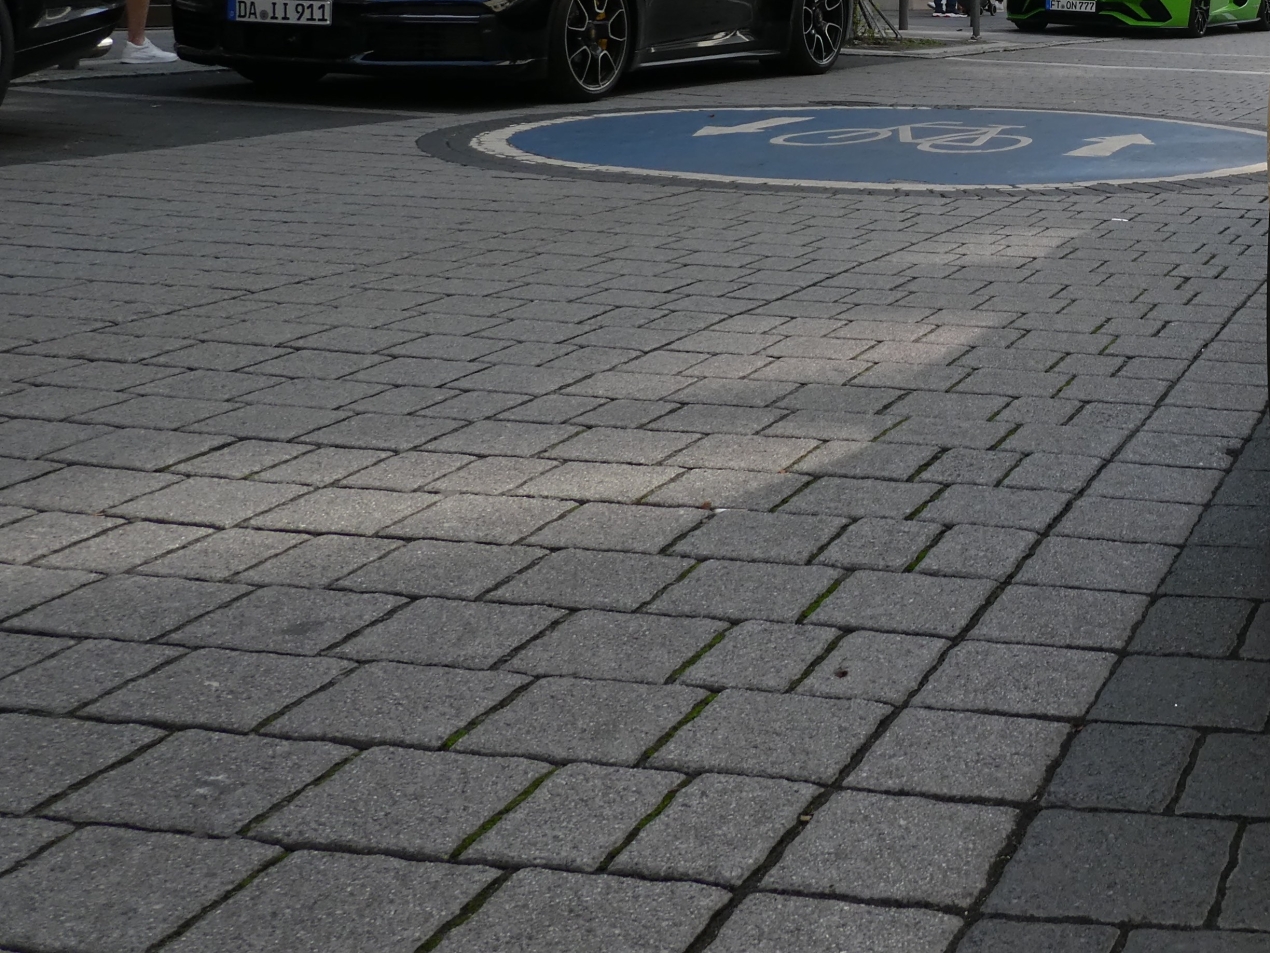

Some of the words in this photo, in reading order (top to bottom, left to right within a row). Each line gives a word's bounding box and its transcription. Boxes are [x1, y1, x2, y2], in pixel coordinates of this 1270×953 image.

[237, 0, 258, 19] DA
[270, 1, 290, 20] II
[295, 3, 328, 22] 911
[1050, 0, 1061, 9] FT
[1078, 1, 1095, 11] 777
